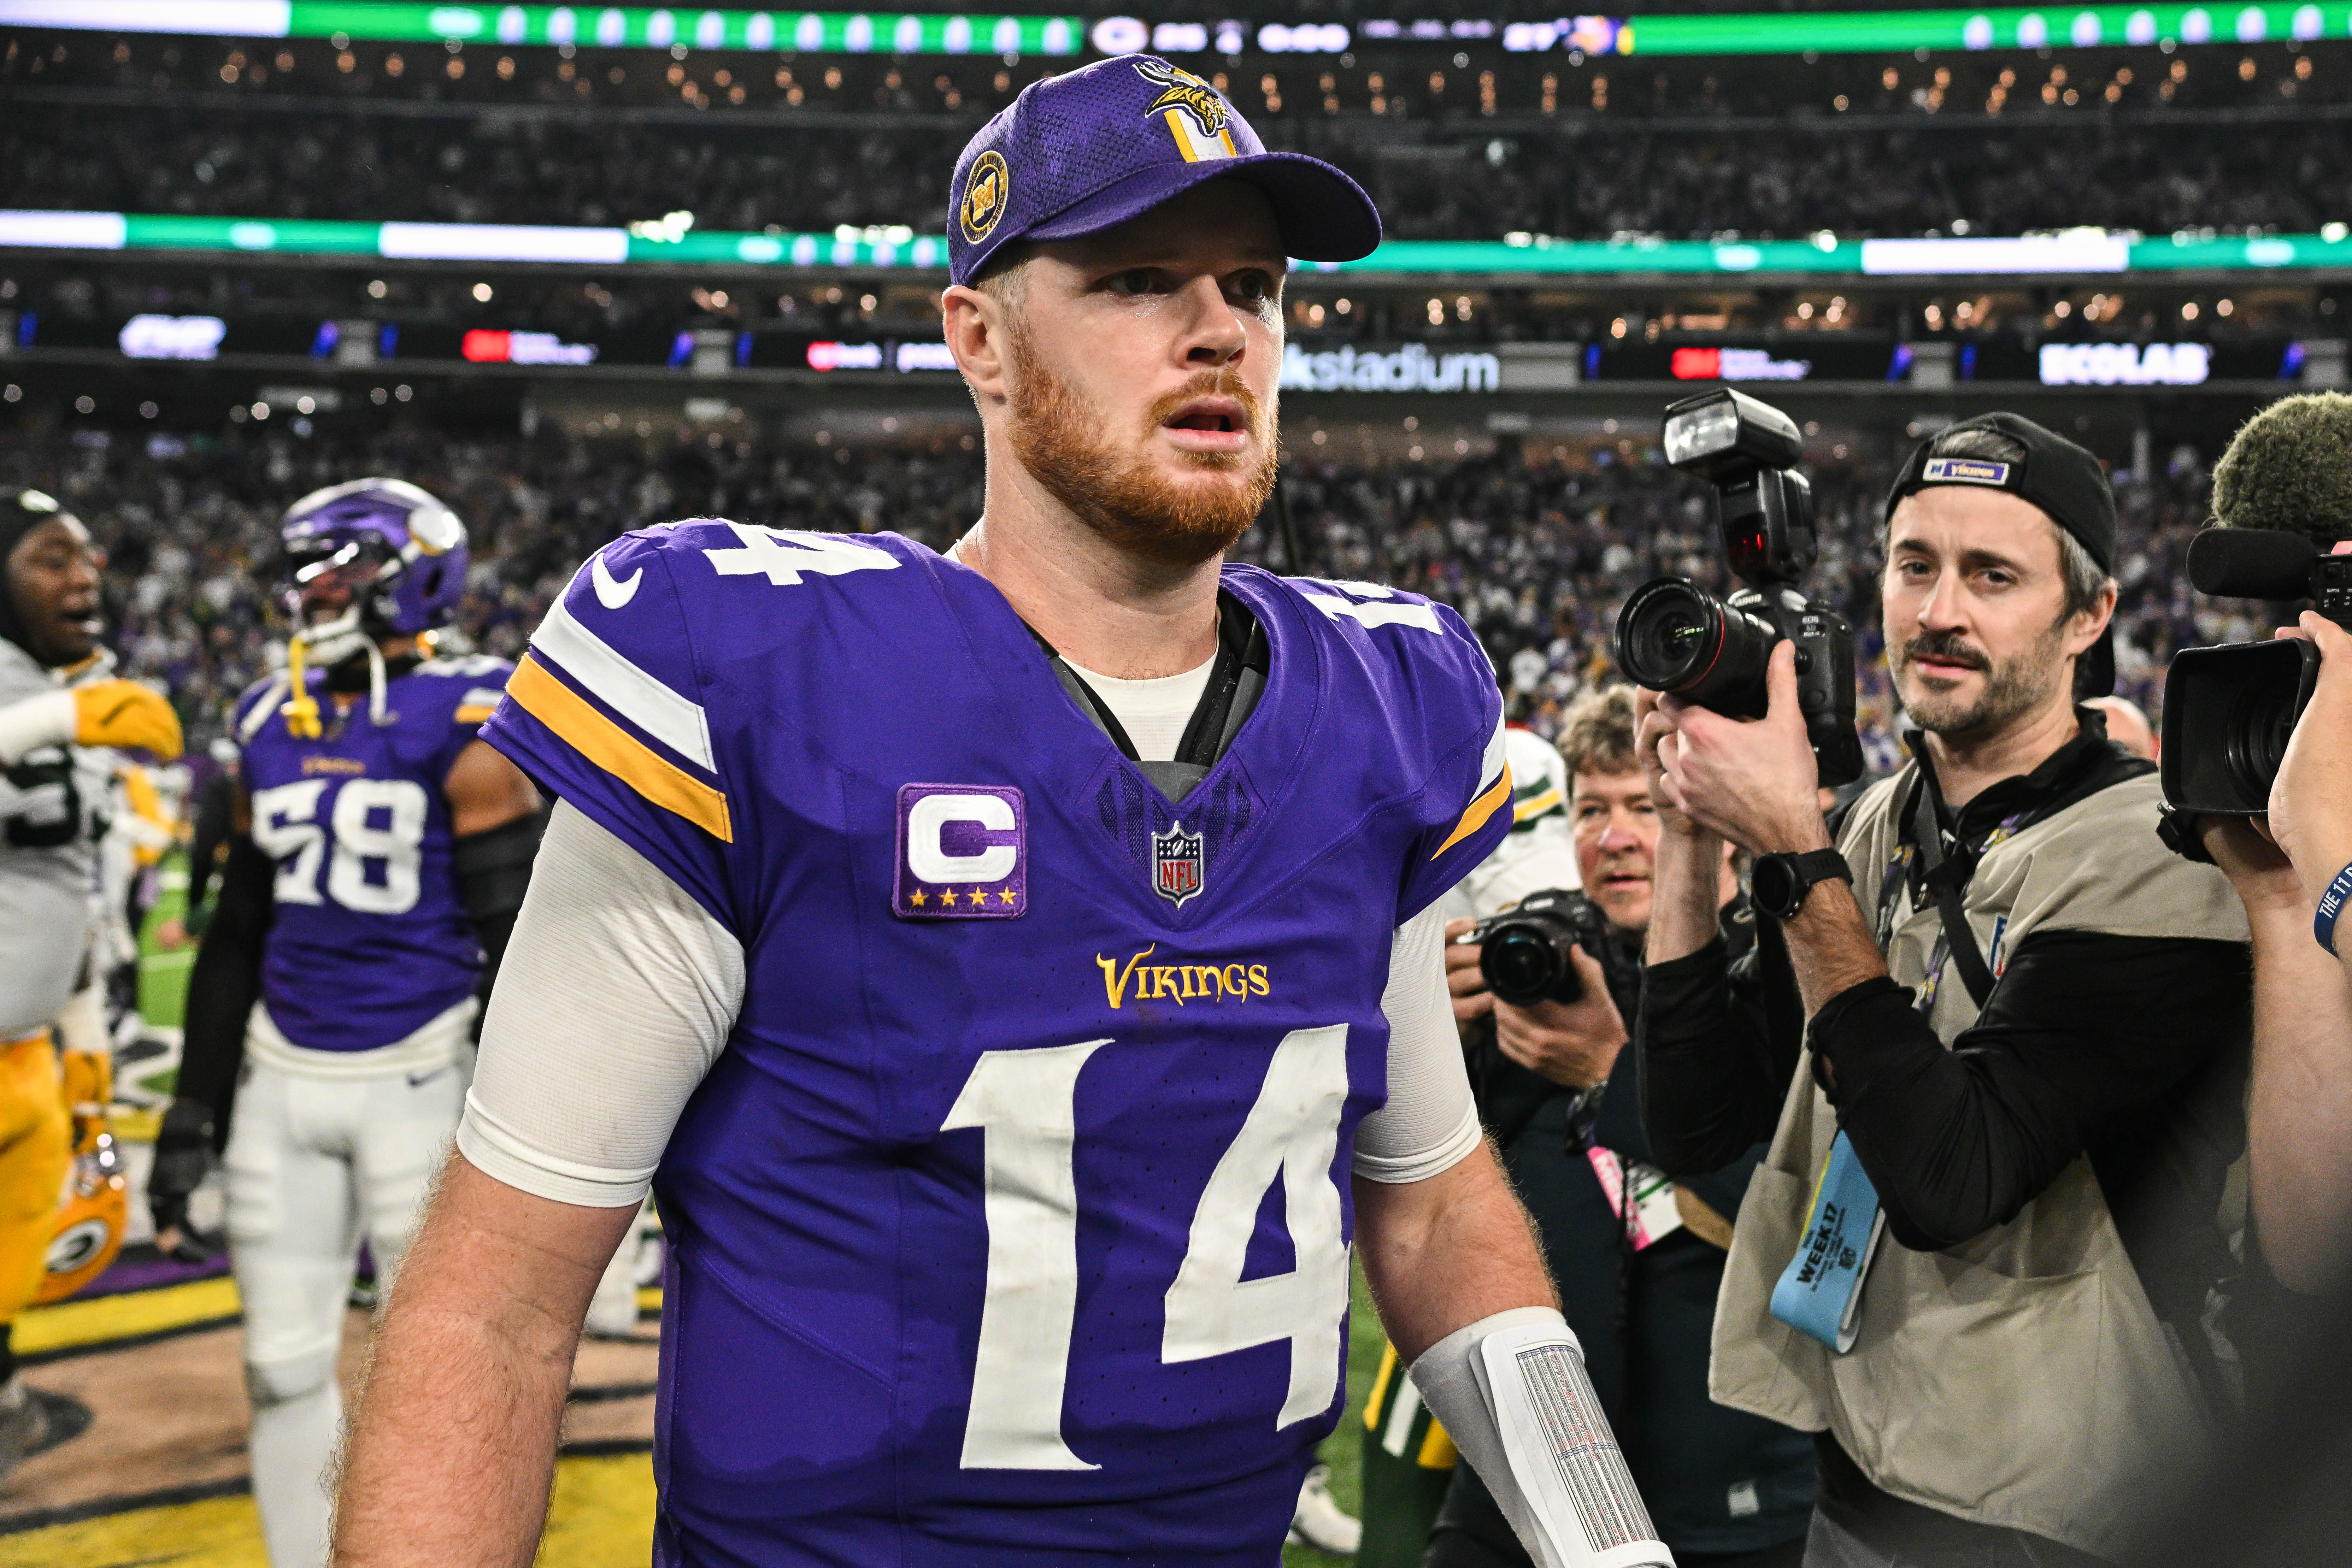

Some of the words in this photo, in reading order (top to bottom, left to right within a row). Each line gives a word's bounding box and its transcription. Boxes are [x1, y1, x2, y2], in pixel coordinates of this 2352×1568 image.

[2040, 343, 2209, 386] ECOLAB
[250, 777, 428, 915] 58
[908, 794, 1017, 883] C
[1161, 861, 1196, 892] NFL
[2319, 891, 2340, 918] THE
[2333, 877, 2351, 894] 11
[940, 1023, 1351, 1470] 14
[1797, 1225, 1832, 1283] WEEK
[1823, 1201, 1838, 1222] 17
